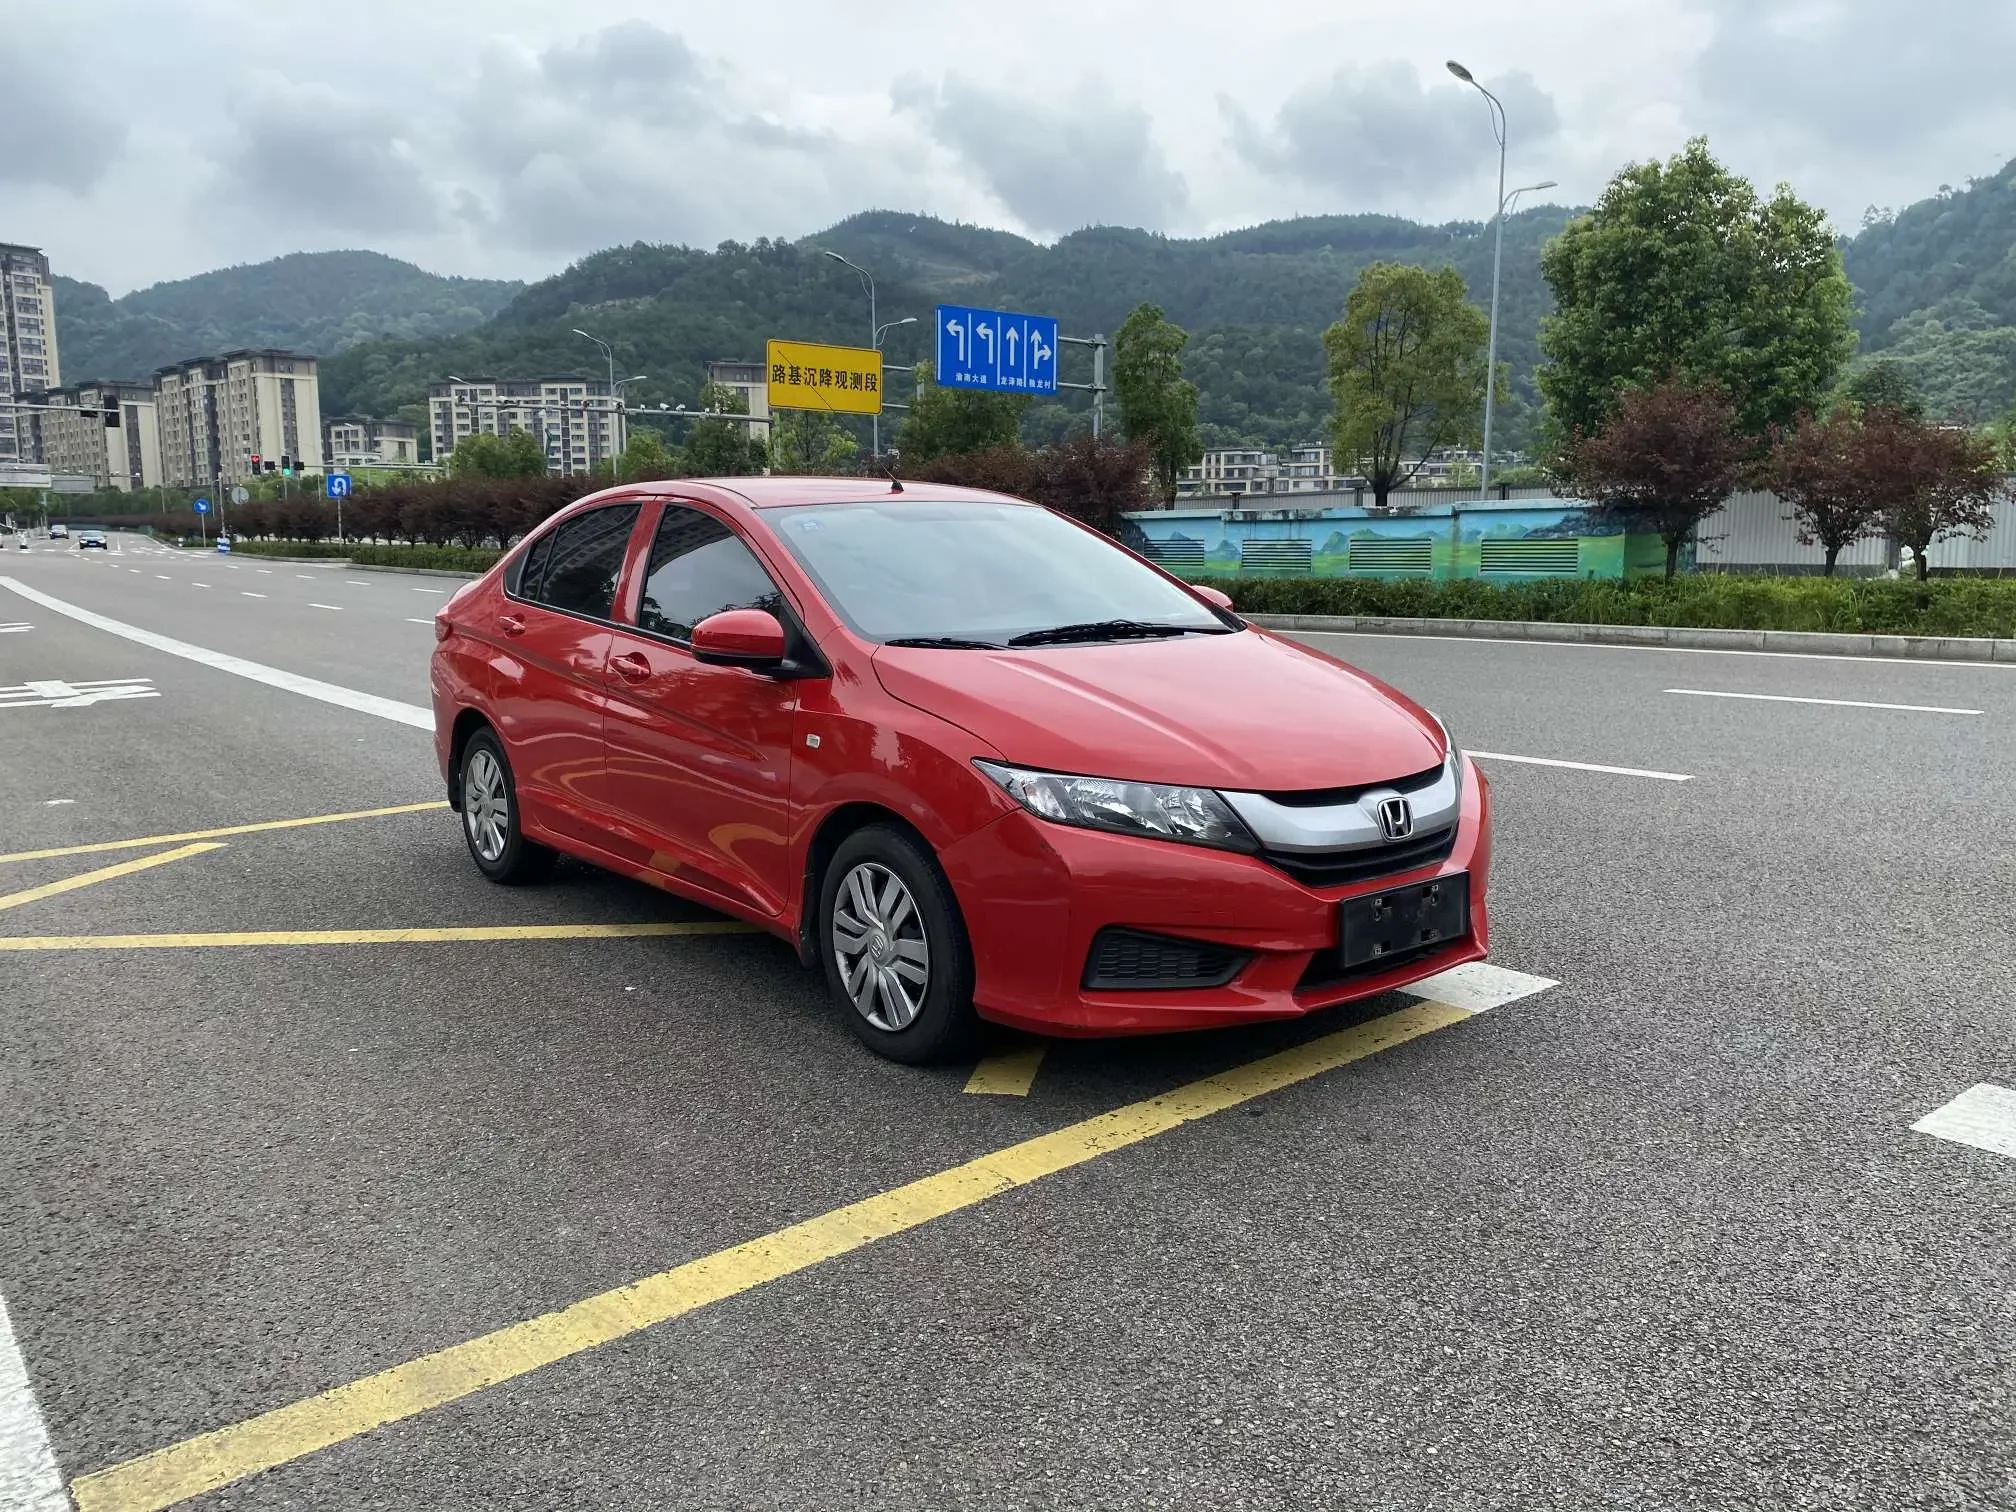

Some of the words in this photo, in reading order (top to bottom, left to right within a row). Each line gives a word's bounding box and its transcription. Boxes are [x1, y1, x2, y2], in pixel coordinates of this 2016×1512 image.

[772, 364, 878, 392] 路基沉降观测段
[956, 372, 987, 384] 渝南大道
